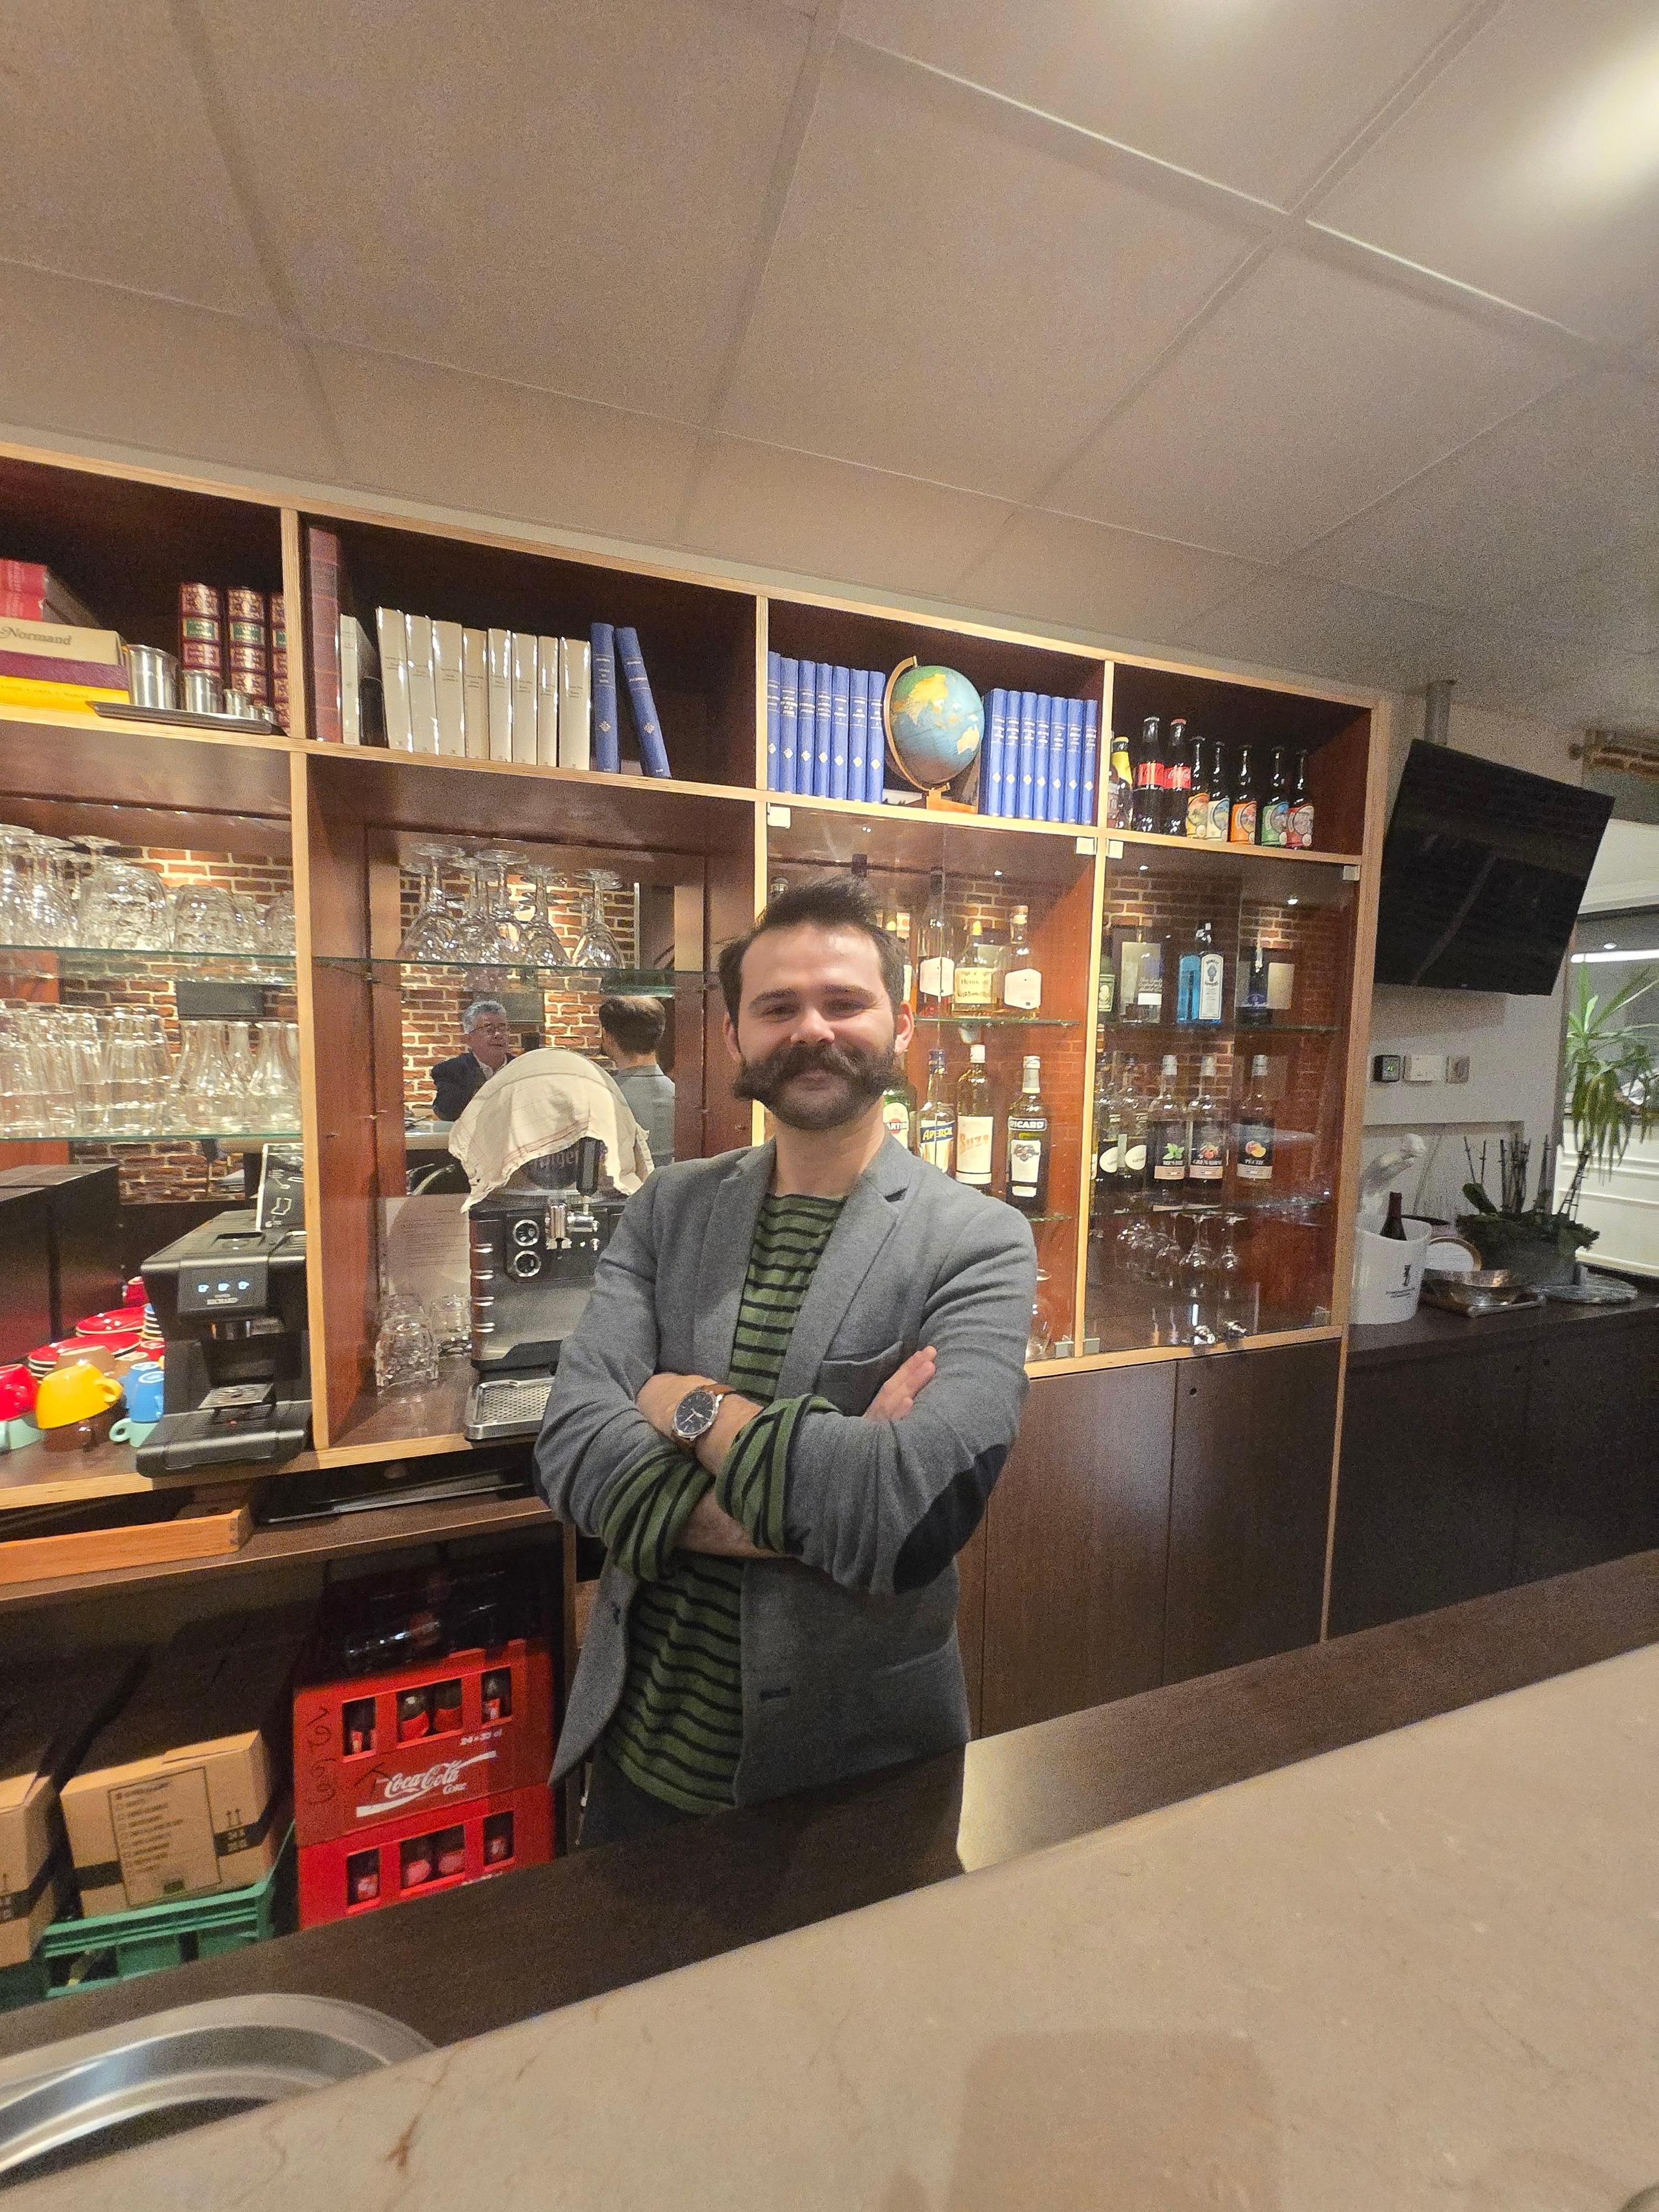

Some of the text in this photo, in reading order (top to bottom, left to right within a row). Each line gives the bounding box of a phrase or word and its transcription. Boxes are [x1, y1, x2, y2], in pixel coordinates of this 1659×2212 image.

[0, 626, 72, 645] Normand
[1009, 1120, 1044, 1129] RICARD
[384, 1761, 462, 1799] Coca-Cola
